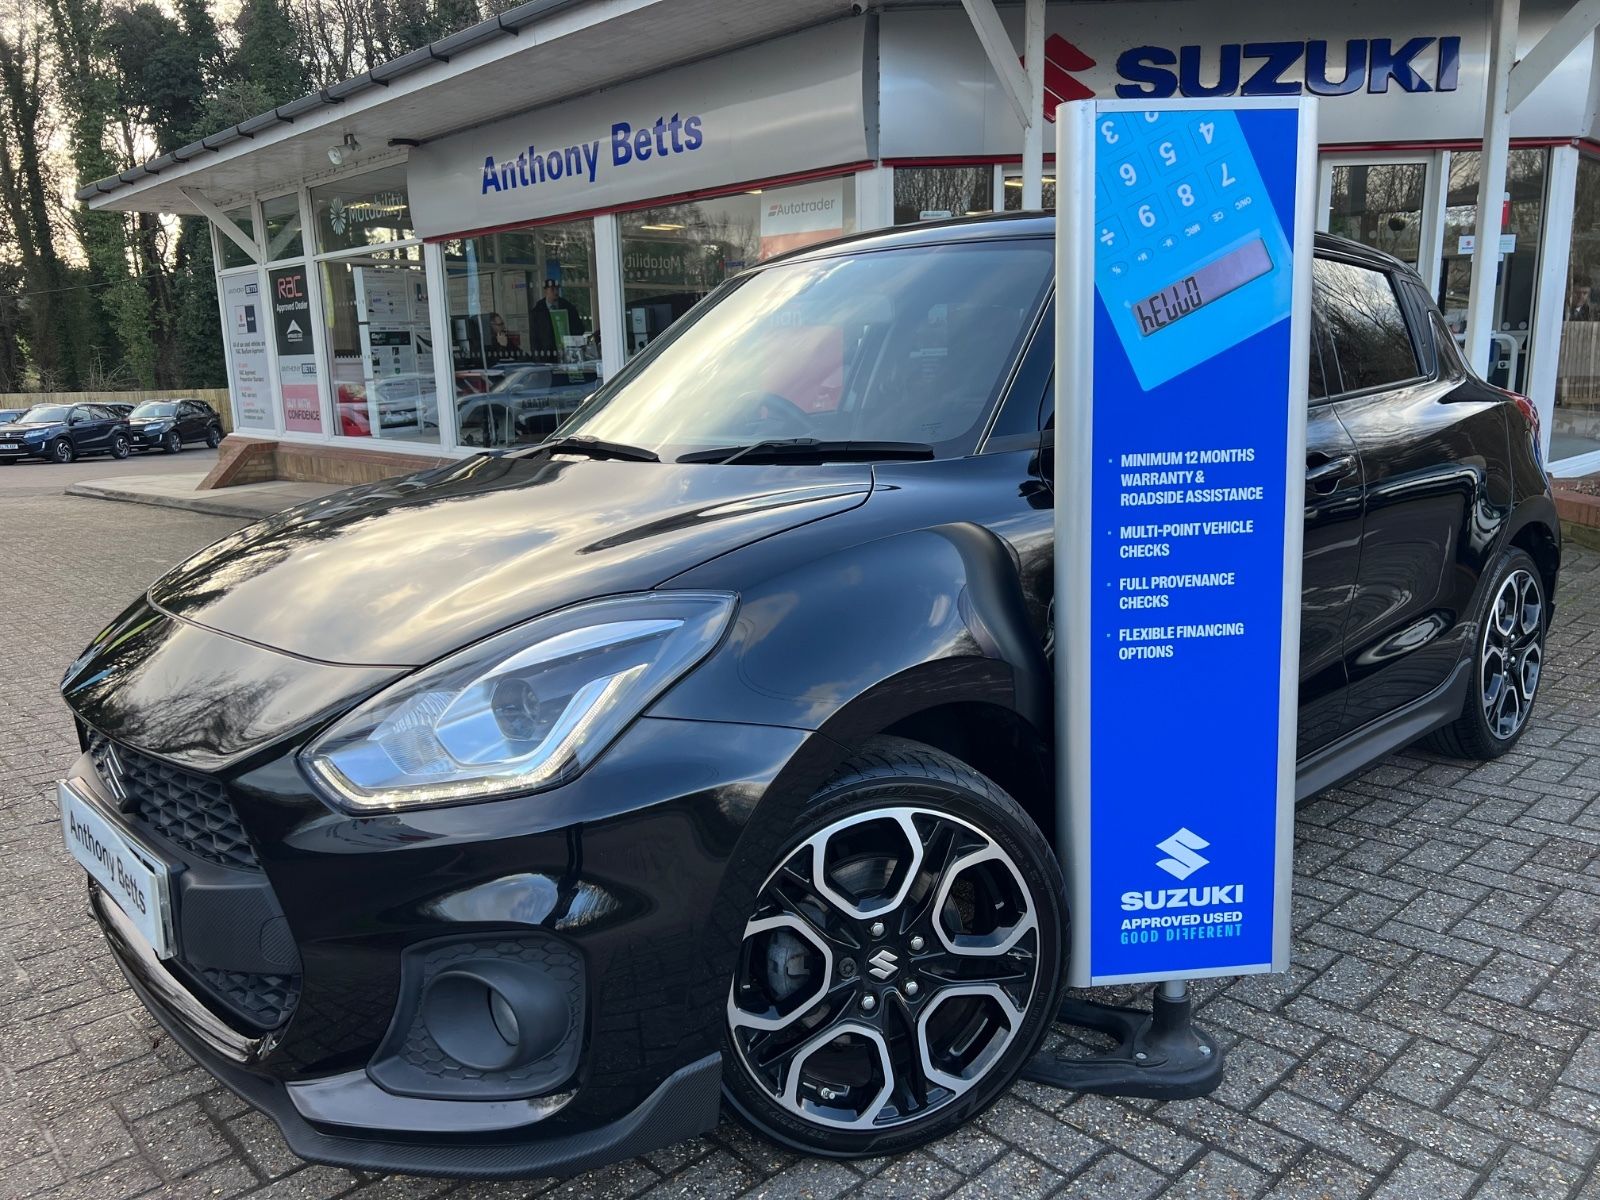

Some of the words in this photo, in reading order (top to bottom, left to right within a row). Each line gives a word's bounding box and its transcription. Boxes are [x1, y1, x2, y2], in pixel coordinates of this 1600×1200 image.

[1114, 36, 1461, 99] SUZUKI
[1101, 120, 1119, 144] 3
[1199, 122, 1215, 144] 4
[482, 140, 600, 195] Anthony
[611, 112, 703, 166] Betts
[1159, 142, 1177, 166] 5
[1221, 162, 1236, 187] 7
[1177, 184, 1195, 207] 8
[776, 196, 836, 216] Autotrader
[287, 409, 320, 421] CONFIDENCE
[1121, 452, 1183, 467] MINIMUM
[1184, 451, 1198, 464] 12
[1200, 448, 1255, 464] MONTHS
[1121, 470, 1193, 487] WARRANTY
[1195, 470, 1205, 484] &
[1120, 491, 1184, 506] ROADSIDE
[1186, 487, 1264, 503] ASSISTANCE
[1120, 522, 1201, 539] MULTI-POINT
[1203, 520, 1254, 535] VEHICLE
[1120, 543, 1170, 559] CHECKS
[1119, 577, 1149, 591] FULL
[1151, 572, 1235, 589] PROVENANCE
[1119, 594, 1169, 609] CHECKS
[1119, 626, 1175, 641] FLEXIBLE
[1176, 622, 1244, 638] FINANCING
[1119, 645, 1174, 660] OPTIONS
[70, 810, 116, 882] Anthony
[117, 855, 147, 915] Betts
[1120, 884, 1244, 911] SUZUKI
[1121, 914, 1201, 930] APPROVED
[1203, 911, 1243, 924] USED
[1120, 930, 1159, 945] GOOD
[1166, 923, 1243, 941] DIFFERENT
